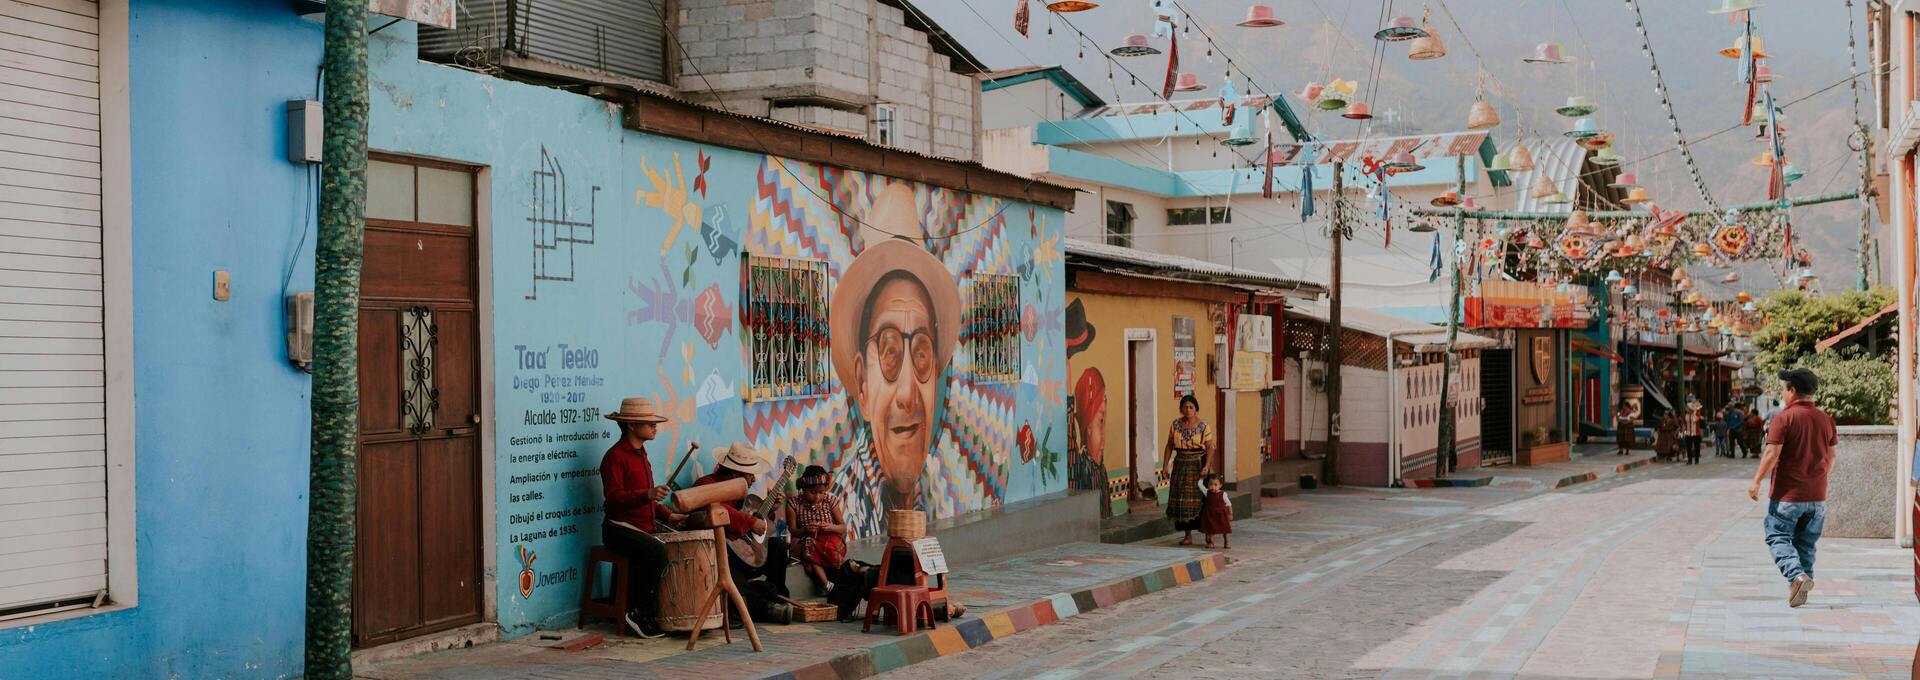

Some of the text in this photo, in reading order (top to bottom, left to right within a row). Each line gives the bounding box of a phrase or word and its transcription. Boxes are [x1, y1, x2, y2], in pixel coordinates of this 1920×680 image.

[558, 343, 599, 369] Teeko
[513, 375, 540, 393] Diego
[524, 409, 557, 425] Alcalde
[510, 430, 611, 446] Gestionó la introducción de
[510, 454, 517, 463] la
[518, 453, 546, 464] energía
[509, 471, 551, 485] Ampliación
[553, 472, 559, 482] y
[509, 490, 545, 503] las calles.
[510, 511, 535, 525] Dibujó
[536, 512, 543, 521] el
[545, 507, 572, 521] croquis
[572, 506, 581, 516] de
[510, 534, 518, 543] La
[520, 531, 547, 543] Laguna
[549, 528, 558, 538] de
[535, 566, 578, 589] Jovenarte
